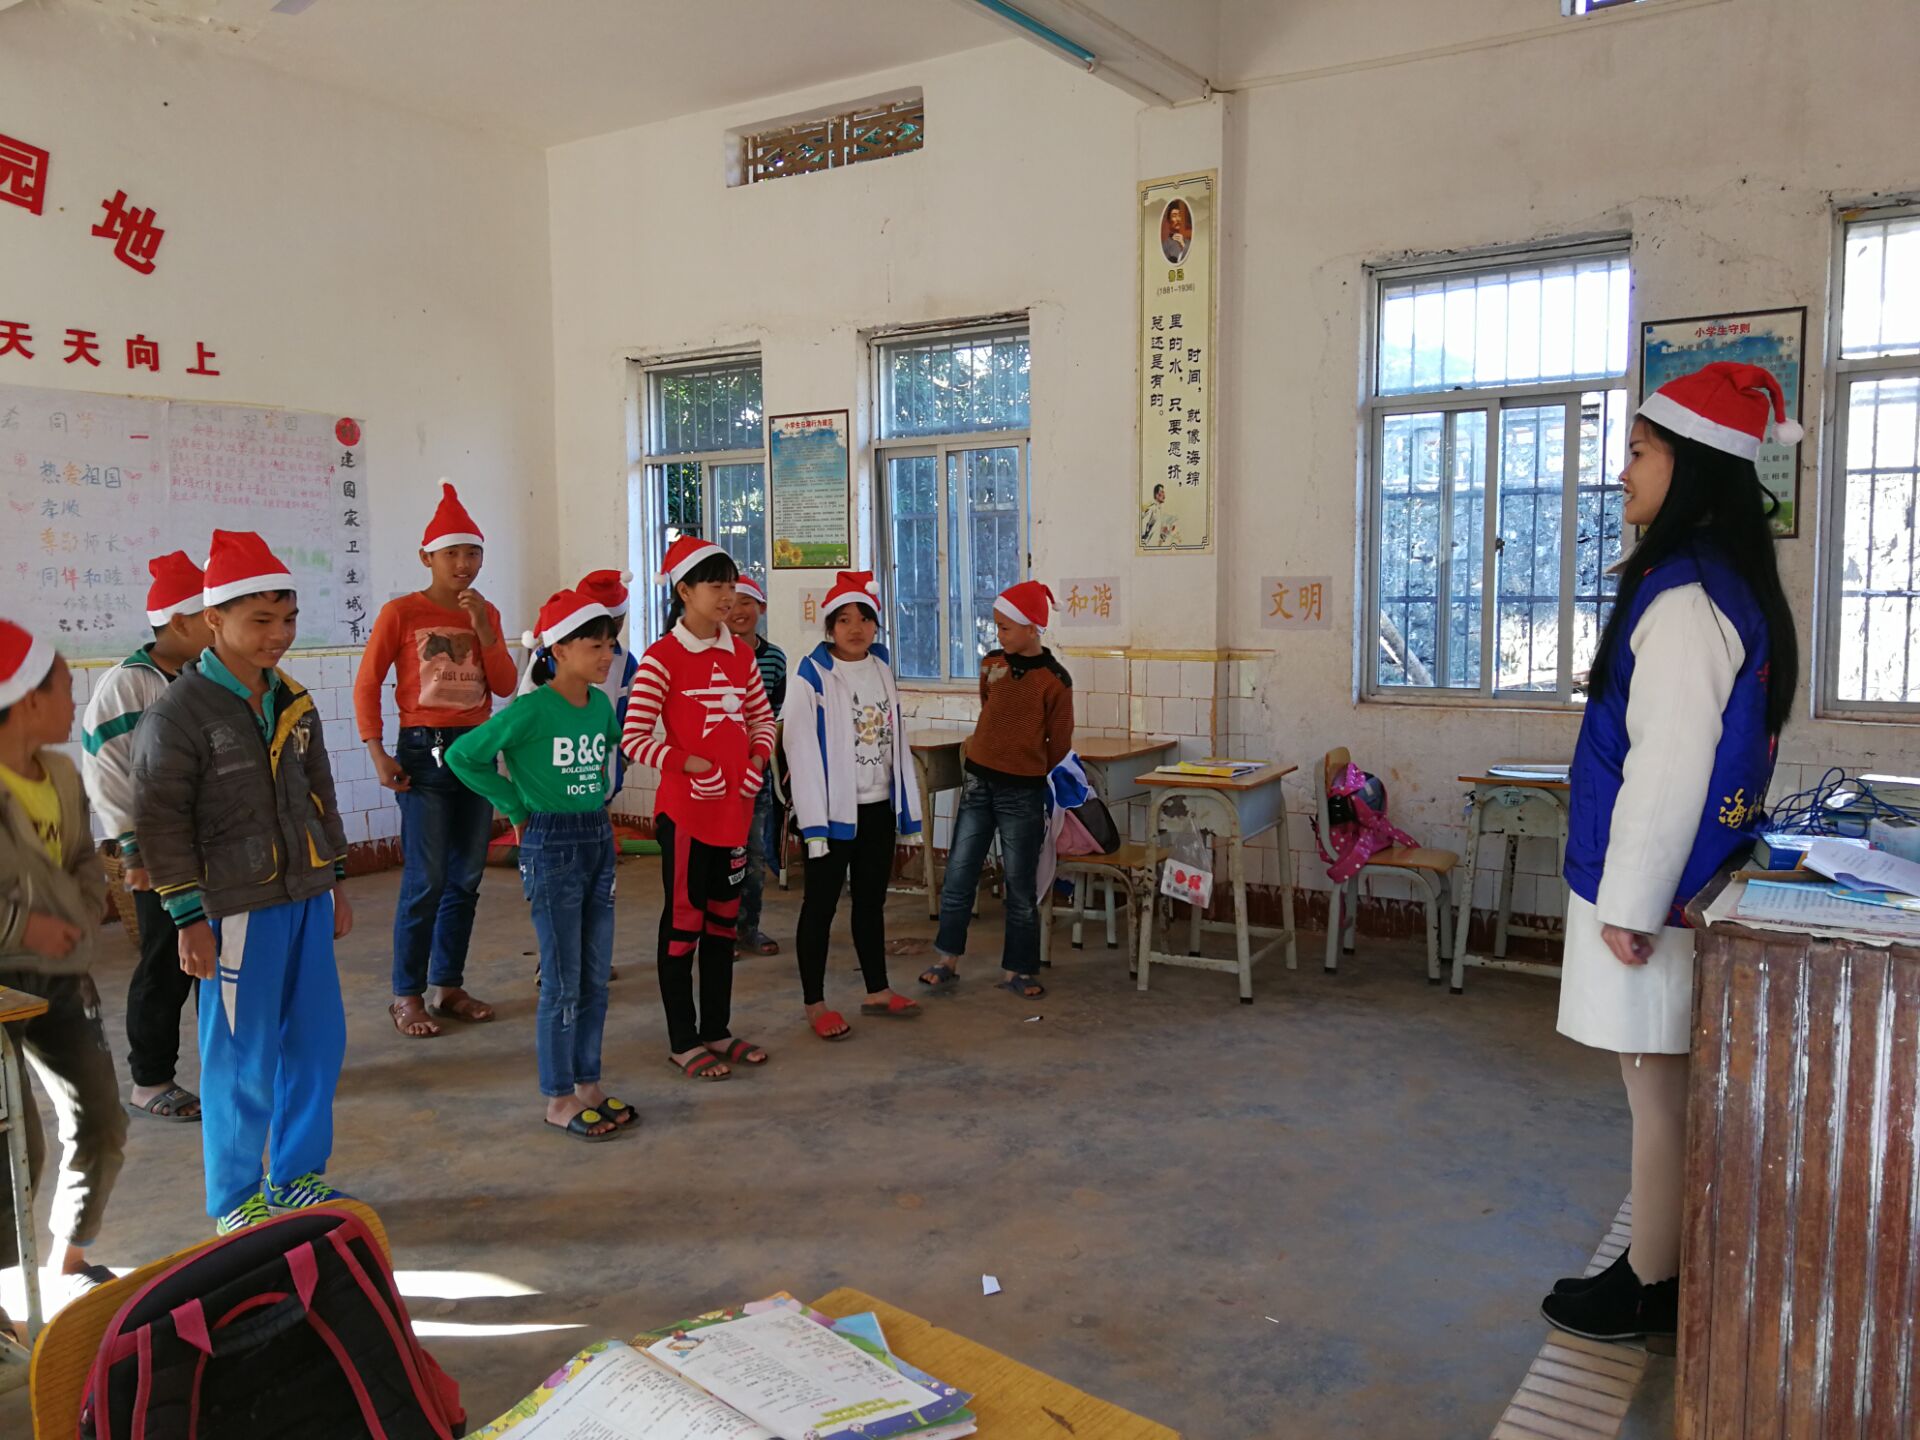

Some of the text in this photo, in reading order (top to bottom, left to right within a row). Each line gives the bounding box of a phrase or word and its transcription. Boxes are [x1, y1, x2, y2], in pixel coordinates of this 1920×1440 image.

[1695, 322, 1751, 339] 小学生守则
[0, 320, 220, 376] 天天向上
[40, 460, 121, 489] 热爱祖国
[41, 566, 125, 592] 同伴和睦
[804, 592, 817, 624] 自
[1066, 583, 1113, 619] 和谐
[1269, 582, 1322, 622] 文明
[552, 732, 606, 766] B&G
